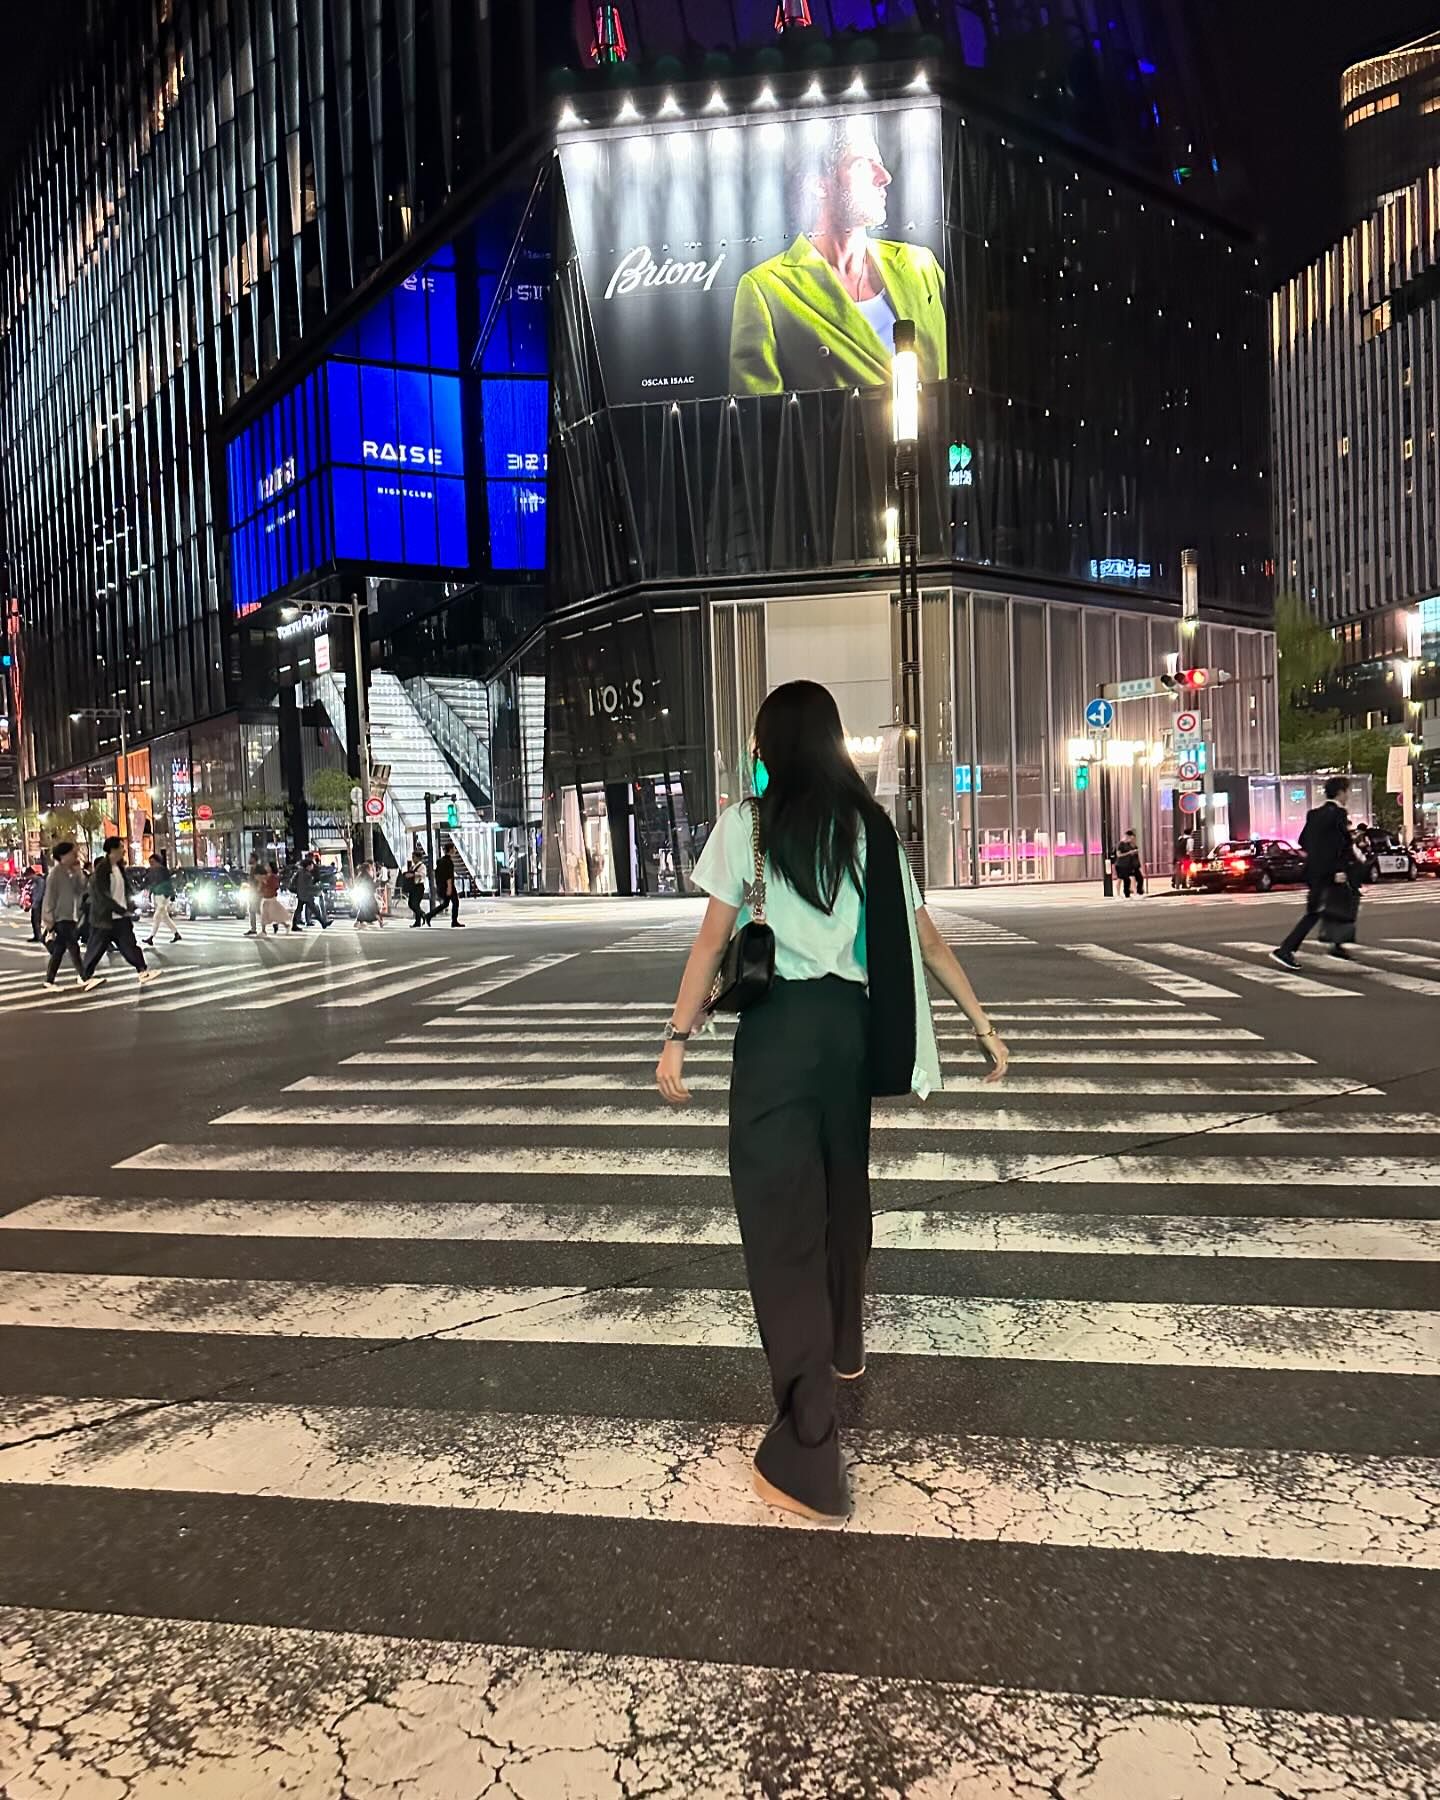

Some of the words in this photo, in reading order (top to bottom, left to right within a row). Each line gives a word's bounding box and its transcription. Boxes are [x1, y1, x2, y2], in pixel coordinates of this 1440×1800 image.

[604, 246, 726, 299] Brioni
[641, 377, 669, 387] OSCAR
[670, 375, 695, 386] ISAAC
[363, 440, 443, 465] RAISE
[377, 487, 433, 499] NIGHTCLUB
[588, 679, 644, 717] OS
